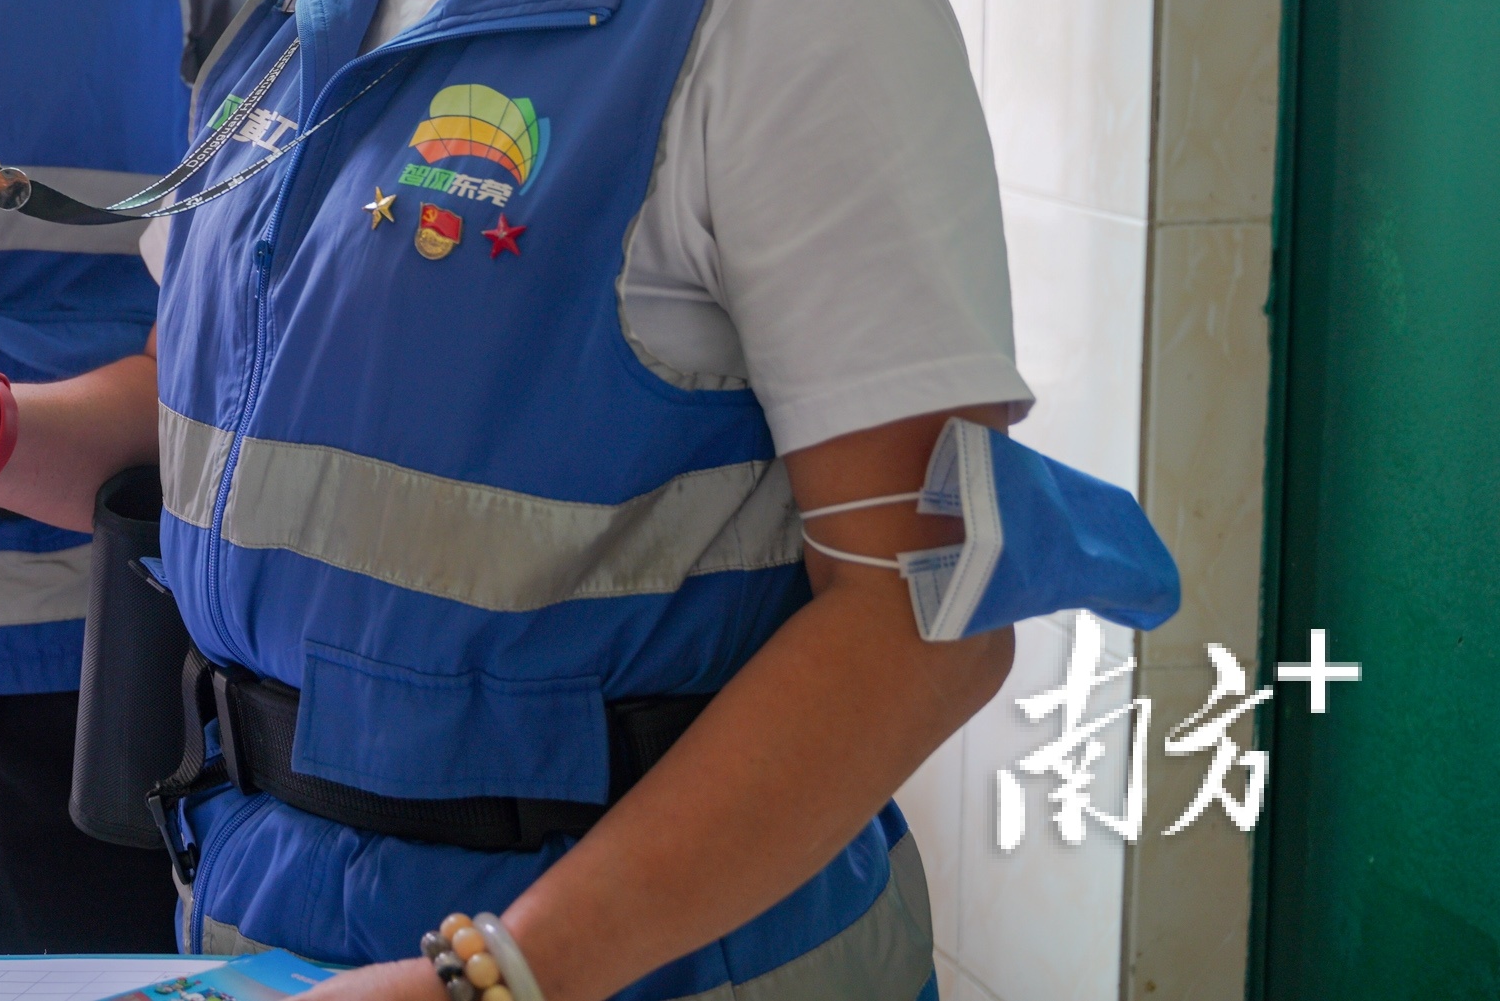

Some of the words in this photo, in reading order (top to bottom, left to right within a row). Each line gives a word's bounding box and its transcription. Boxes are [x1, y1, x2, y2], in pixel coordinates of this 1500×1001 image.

[186, 112, 243, 168] Dongguan
[398, 163, 513, 207] 智网东莞
